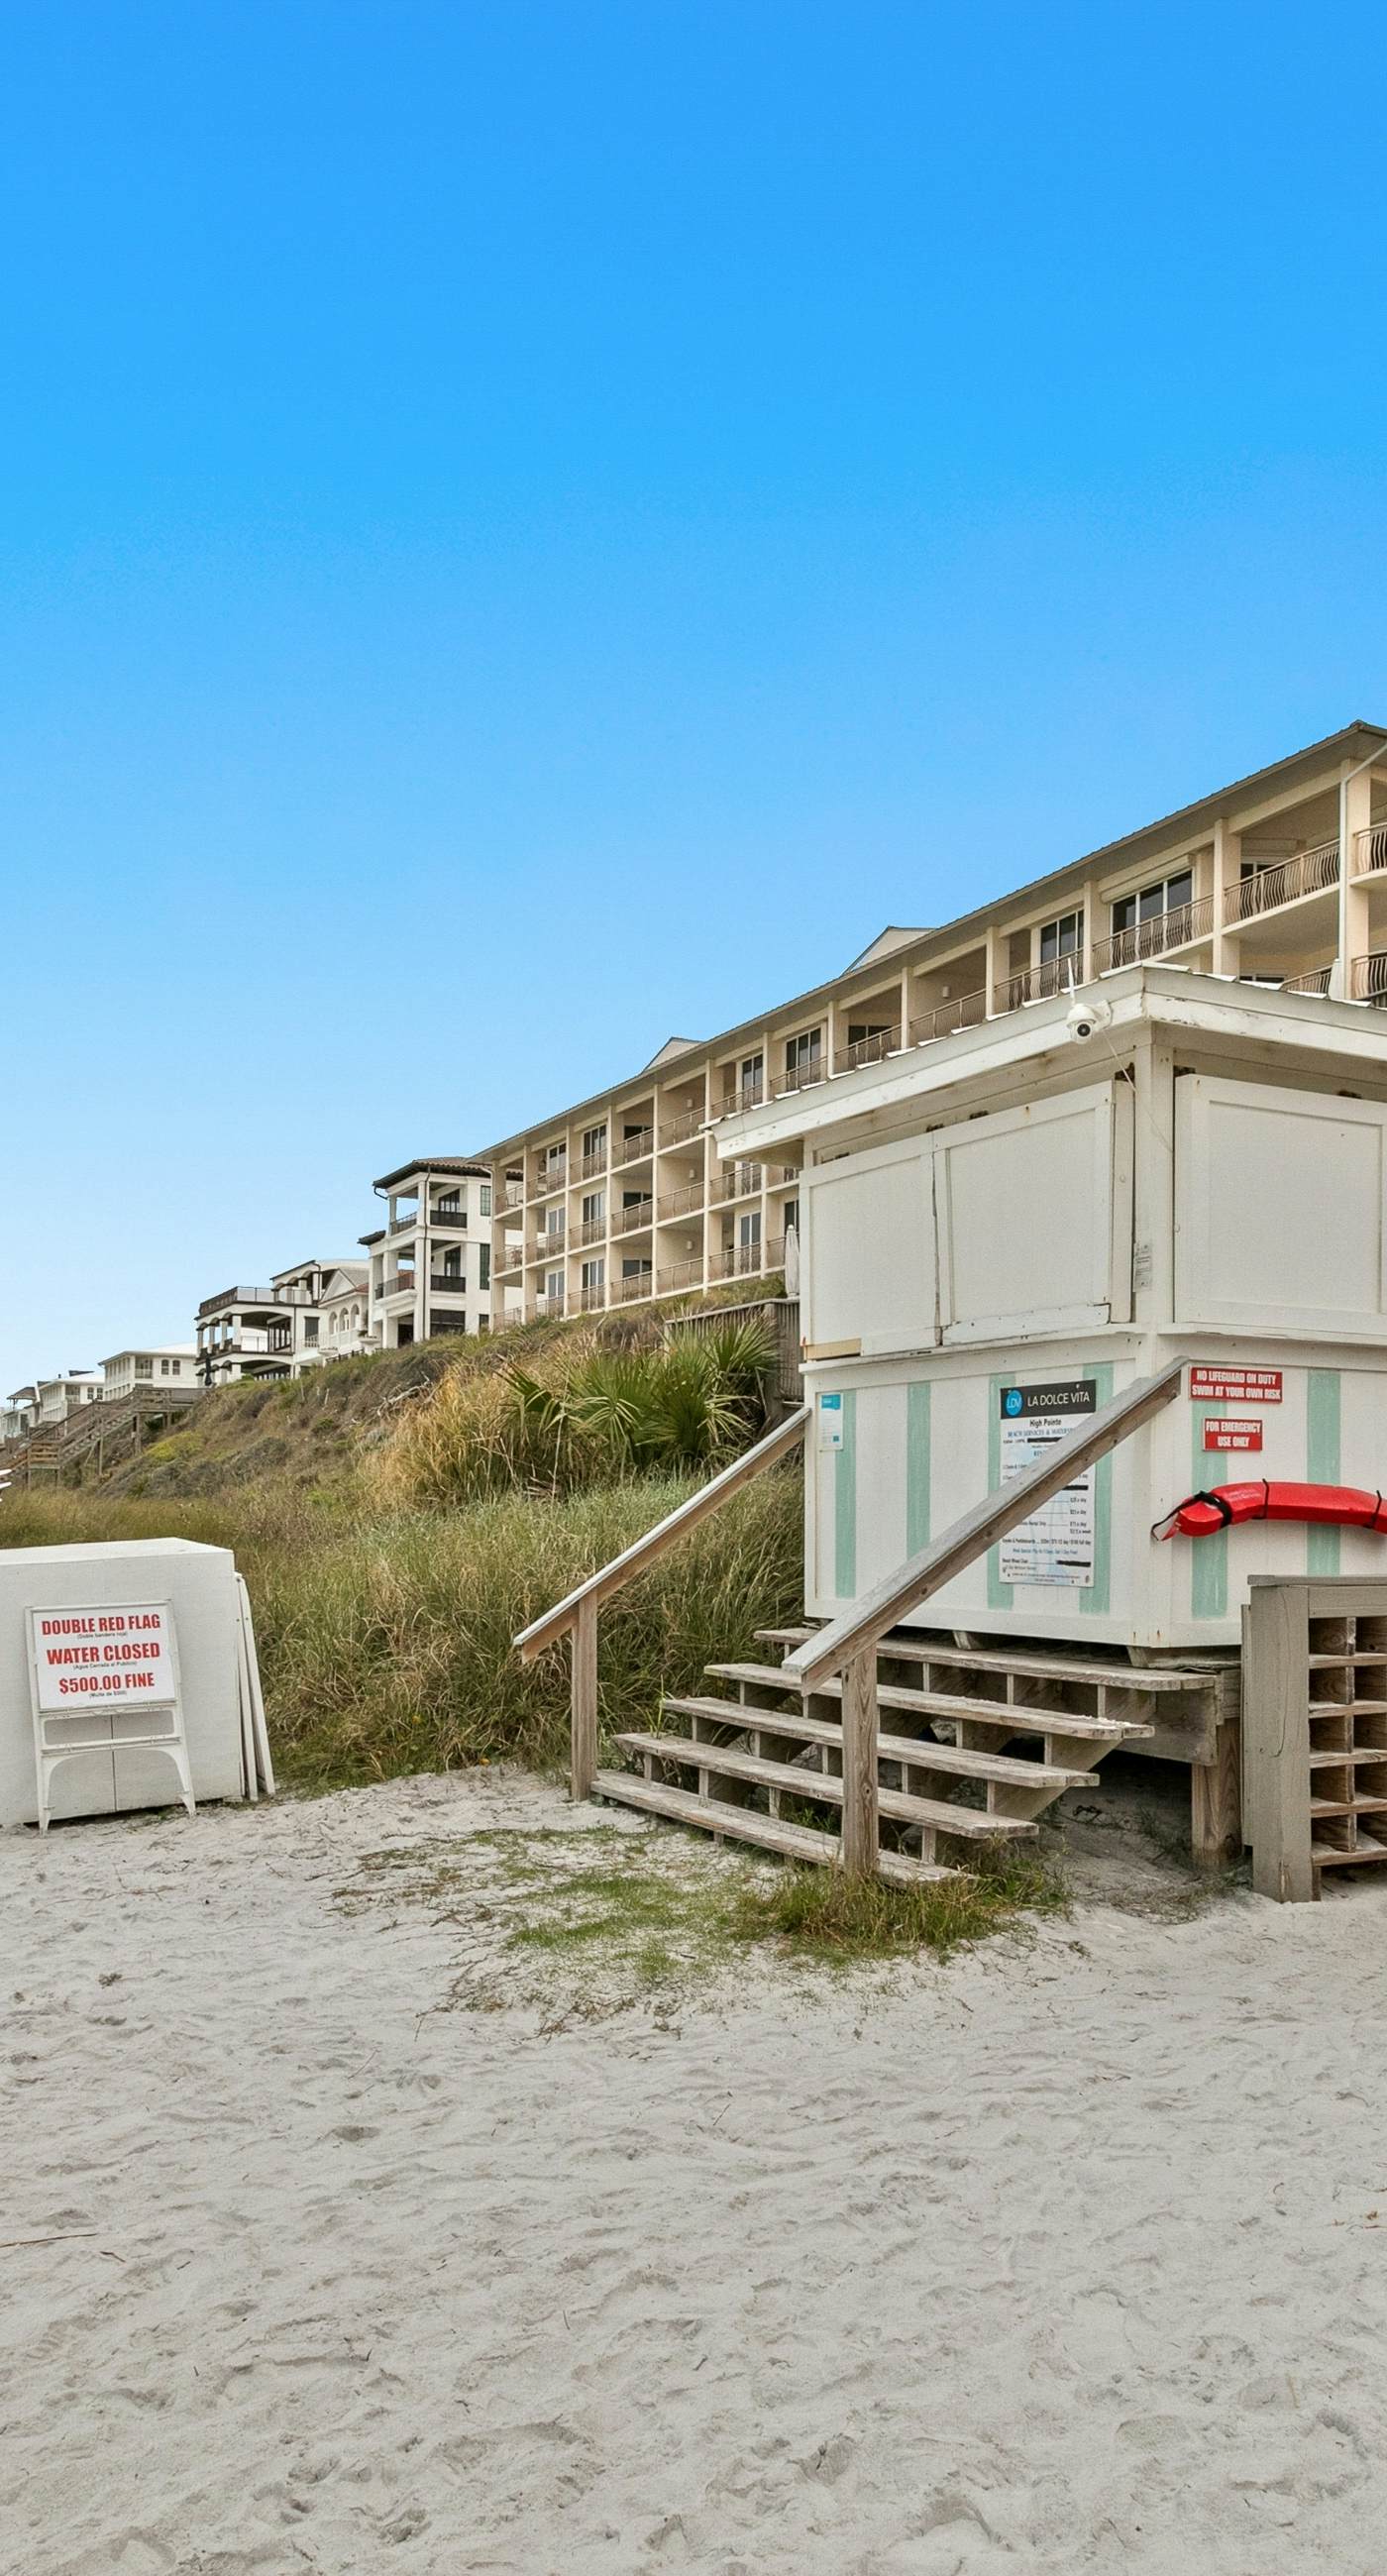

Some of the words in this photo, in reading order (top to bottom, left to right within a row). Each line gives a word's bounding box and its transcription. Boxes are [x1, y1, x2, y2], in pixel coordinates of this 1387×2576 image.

[1197, 1370, 1207, 1380] NO
[1209, 1370, 1245, 1383] LIFEGUARD
[1246, 1373, 1256, 1383] ON
[1257, 1373, 1276, 1385] DUTY
[1027, 1396, 1038, 1407] LA
[1039, 1393, 1069, 1405] DOLCE
[1070, 1391, 1090, 1403] VITA
[1192, 1384, 1214, 1396] SWIM
[1215, 1386, 1224, 1396] AT
[1226, 1386, 1244, 1398] YOUR
[1245, 1388, 1263, 1398] OWN
[1264, 1388, 1281, 1400] RISK
[1029, 1419, 1042, 1428] High
[1206, 1421, 1220, 1432] FOR
[1221, 1421, 1261, 1434] EMERGENCY
[1218, 1436, 1231, 1447] USE
[1232, 1437, 1250, 1448] ONLY
[42, 1618, 95, 1635] DOUBLE
[98, 1616, 125, 1632] RED
[128, 1614, 160, 1630] FLAG
[47, 1647, 100, 1664] WATER
[103, 1643, 160, 1662] CLOSED
[59, 1674, 121, 1694] $500.00
[125, 1672, 155, 1688] FINE
